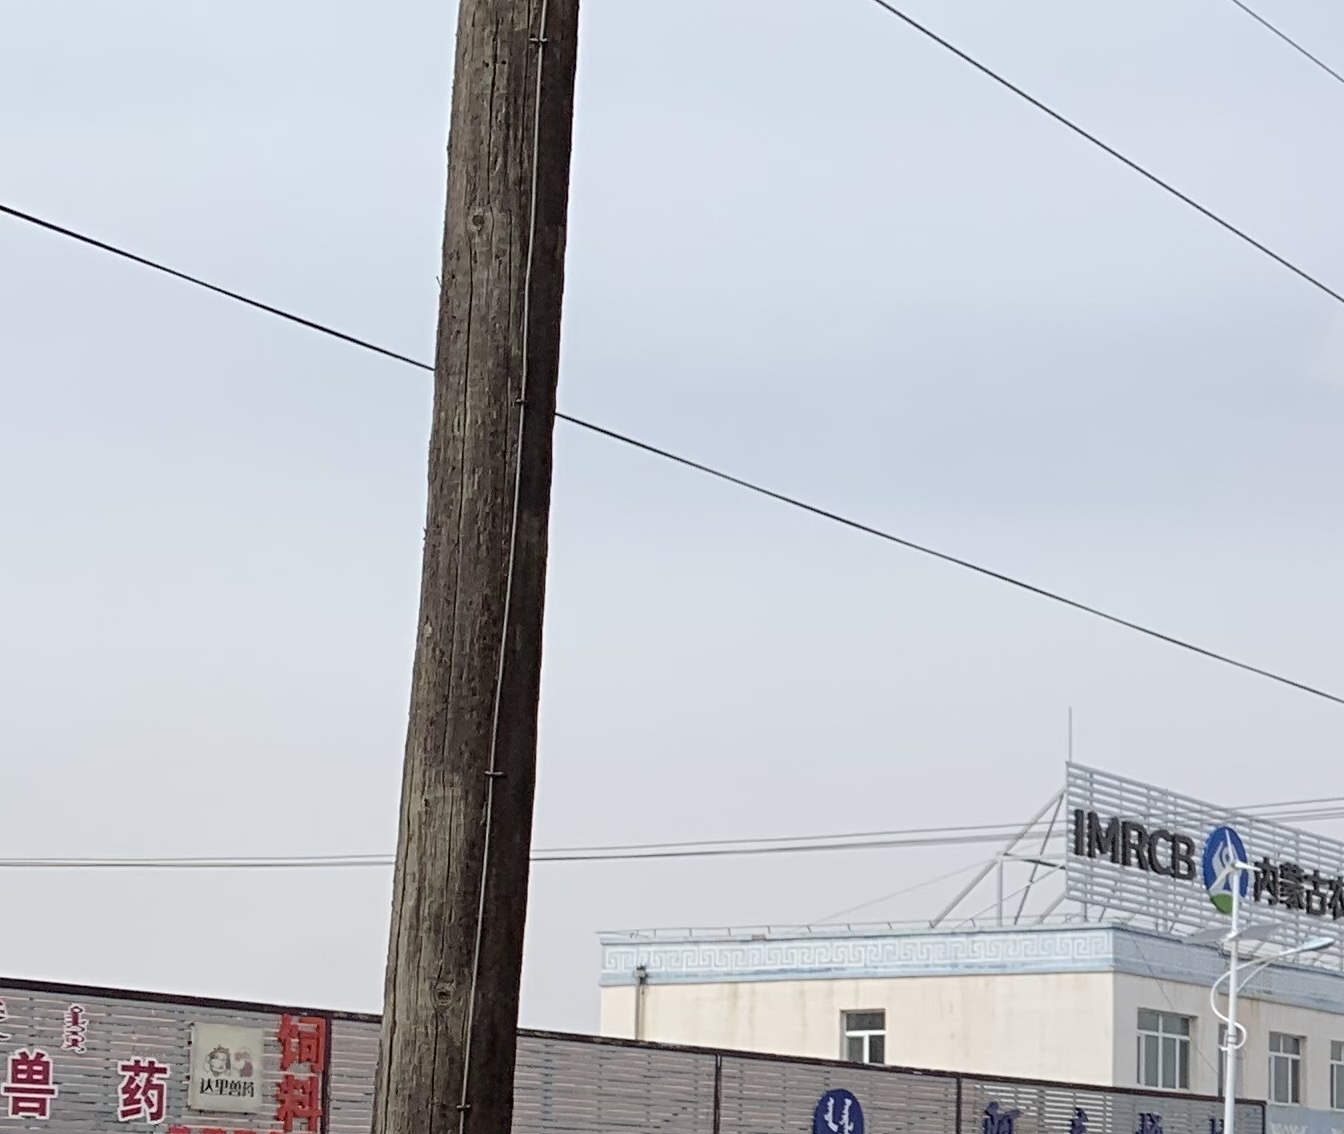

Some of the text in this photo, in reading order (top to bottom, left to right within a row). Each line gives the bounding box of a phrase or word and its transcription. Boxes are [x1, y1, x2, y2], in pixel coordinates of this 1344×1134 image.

[1074, 808, 1197, 880] IMRCB
[1, 1050, 170, 1124] 兽药
[277, 1012, 326, 1133] 饲料
